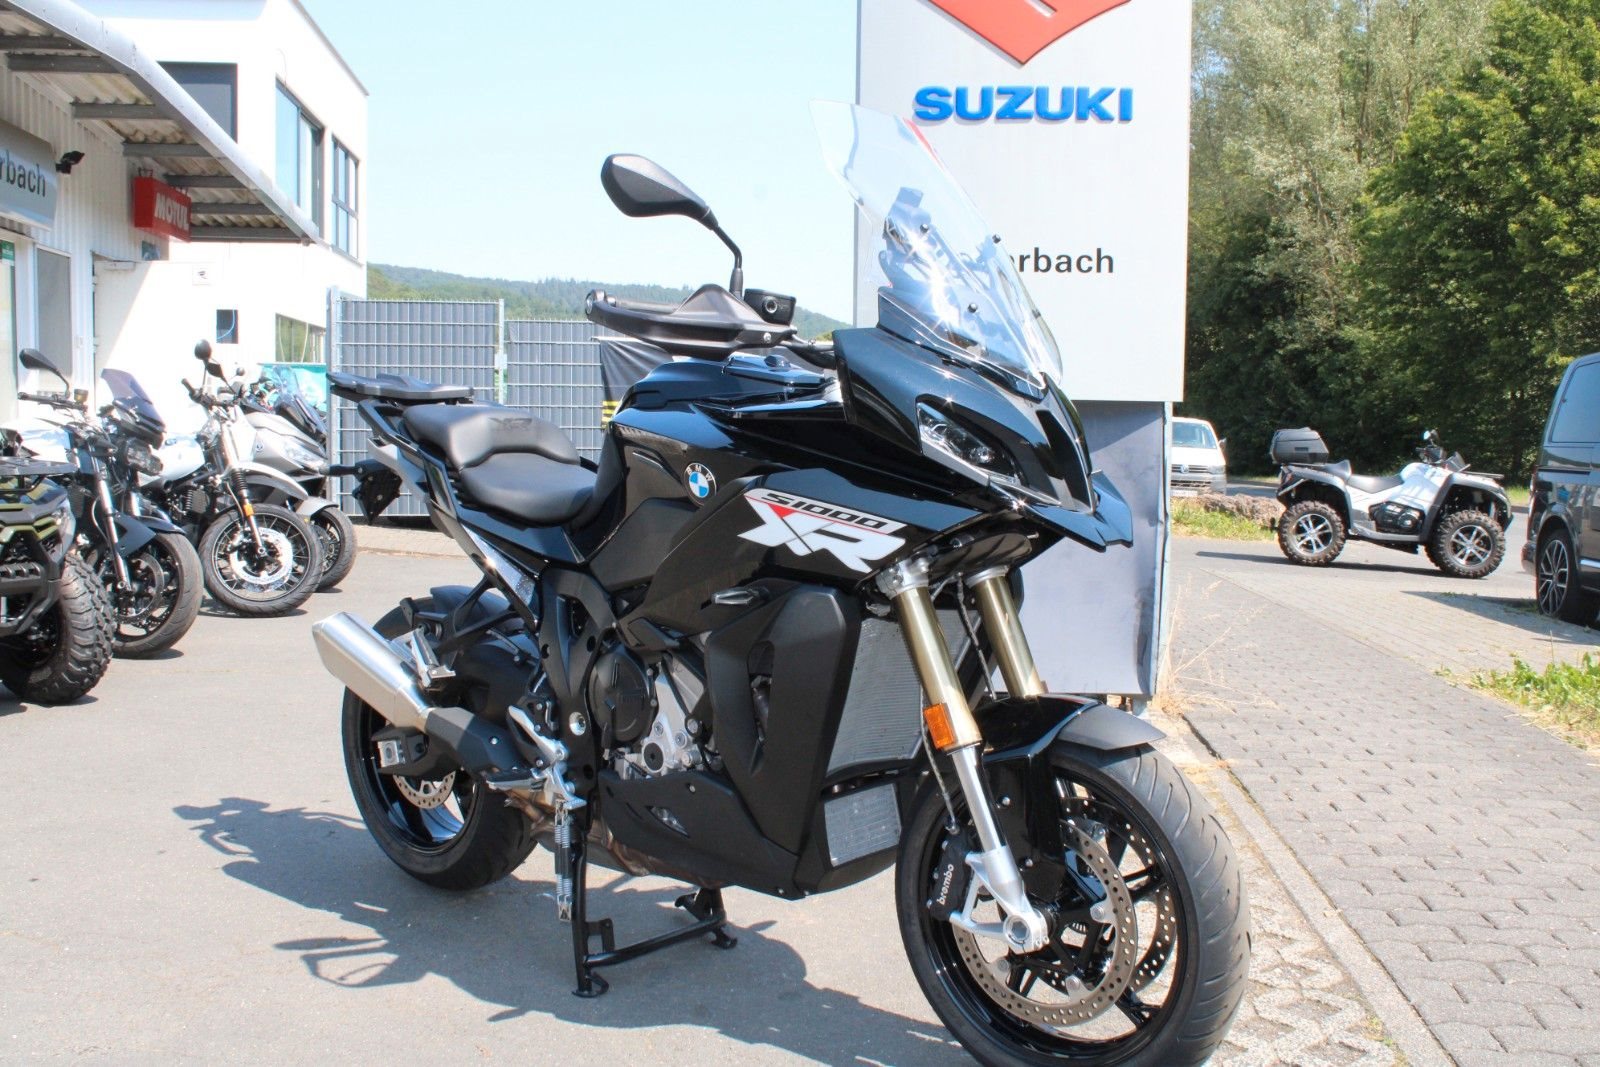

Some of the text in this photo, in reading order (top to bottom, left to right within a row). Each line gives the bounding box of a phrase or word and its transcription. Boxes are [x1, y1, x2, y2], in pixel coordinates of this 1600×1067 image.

[914, 86, 1133, 121] SUZUKI
[154, 191, 190, 231] MOTUL
[1009, 246, 1114, 274] rbach
[761, 492, 889, 530] S1000
[736, 496, 907, 574] XR
